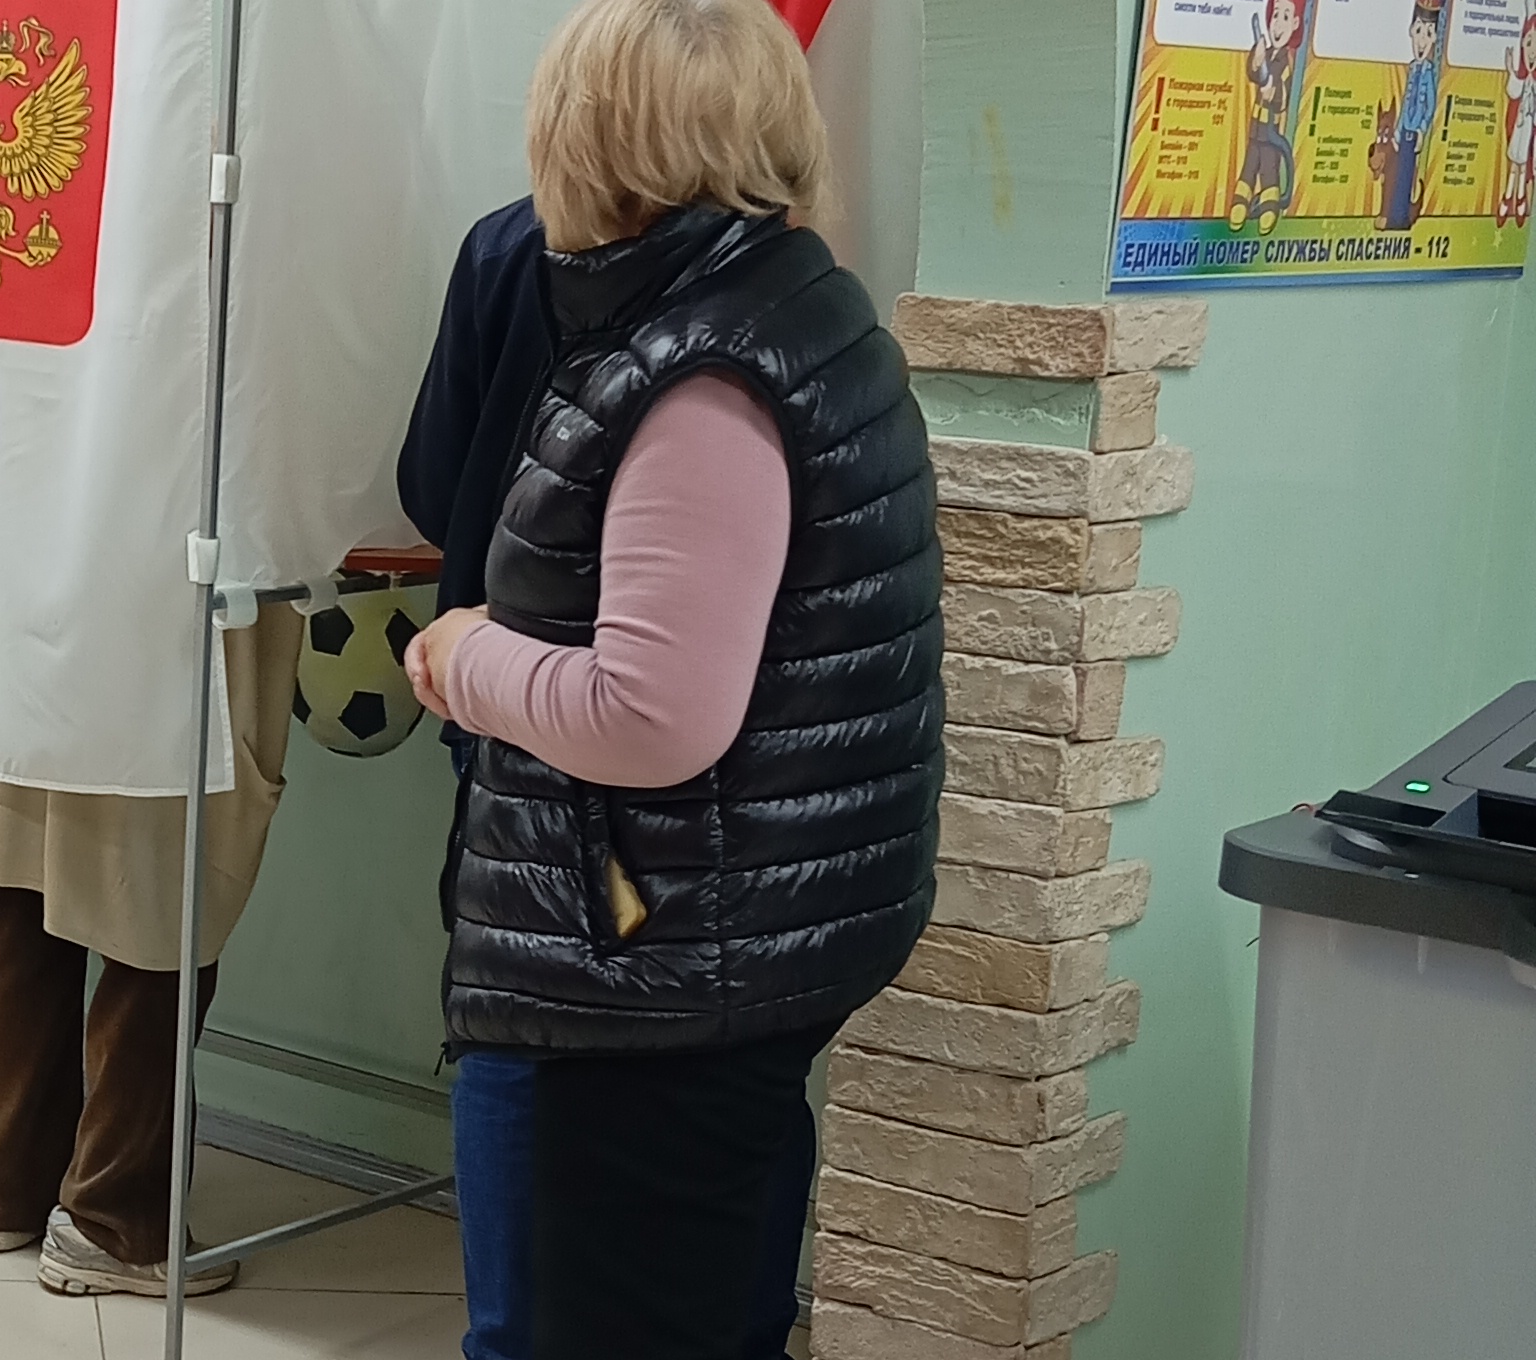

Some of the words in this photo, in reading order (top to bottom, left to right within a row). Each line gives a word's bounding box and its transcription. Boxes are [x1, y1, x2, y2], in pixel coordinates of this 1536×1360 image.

[1122, 237, 1200, 272] ЕДИНЫЙ
[1204, 240, 1260, 264] НОМЕР
[1265, 238, 1332, 263] СЛУЖБЫ
[1335, 237, 1412, 261] СПАСЕНИЯ
[1428, 236, 1450, 258] 112
